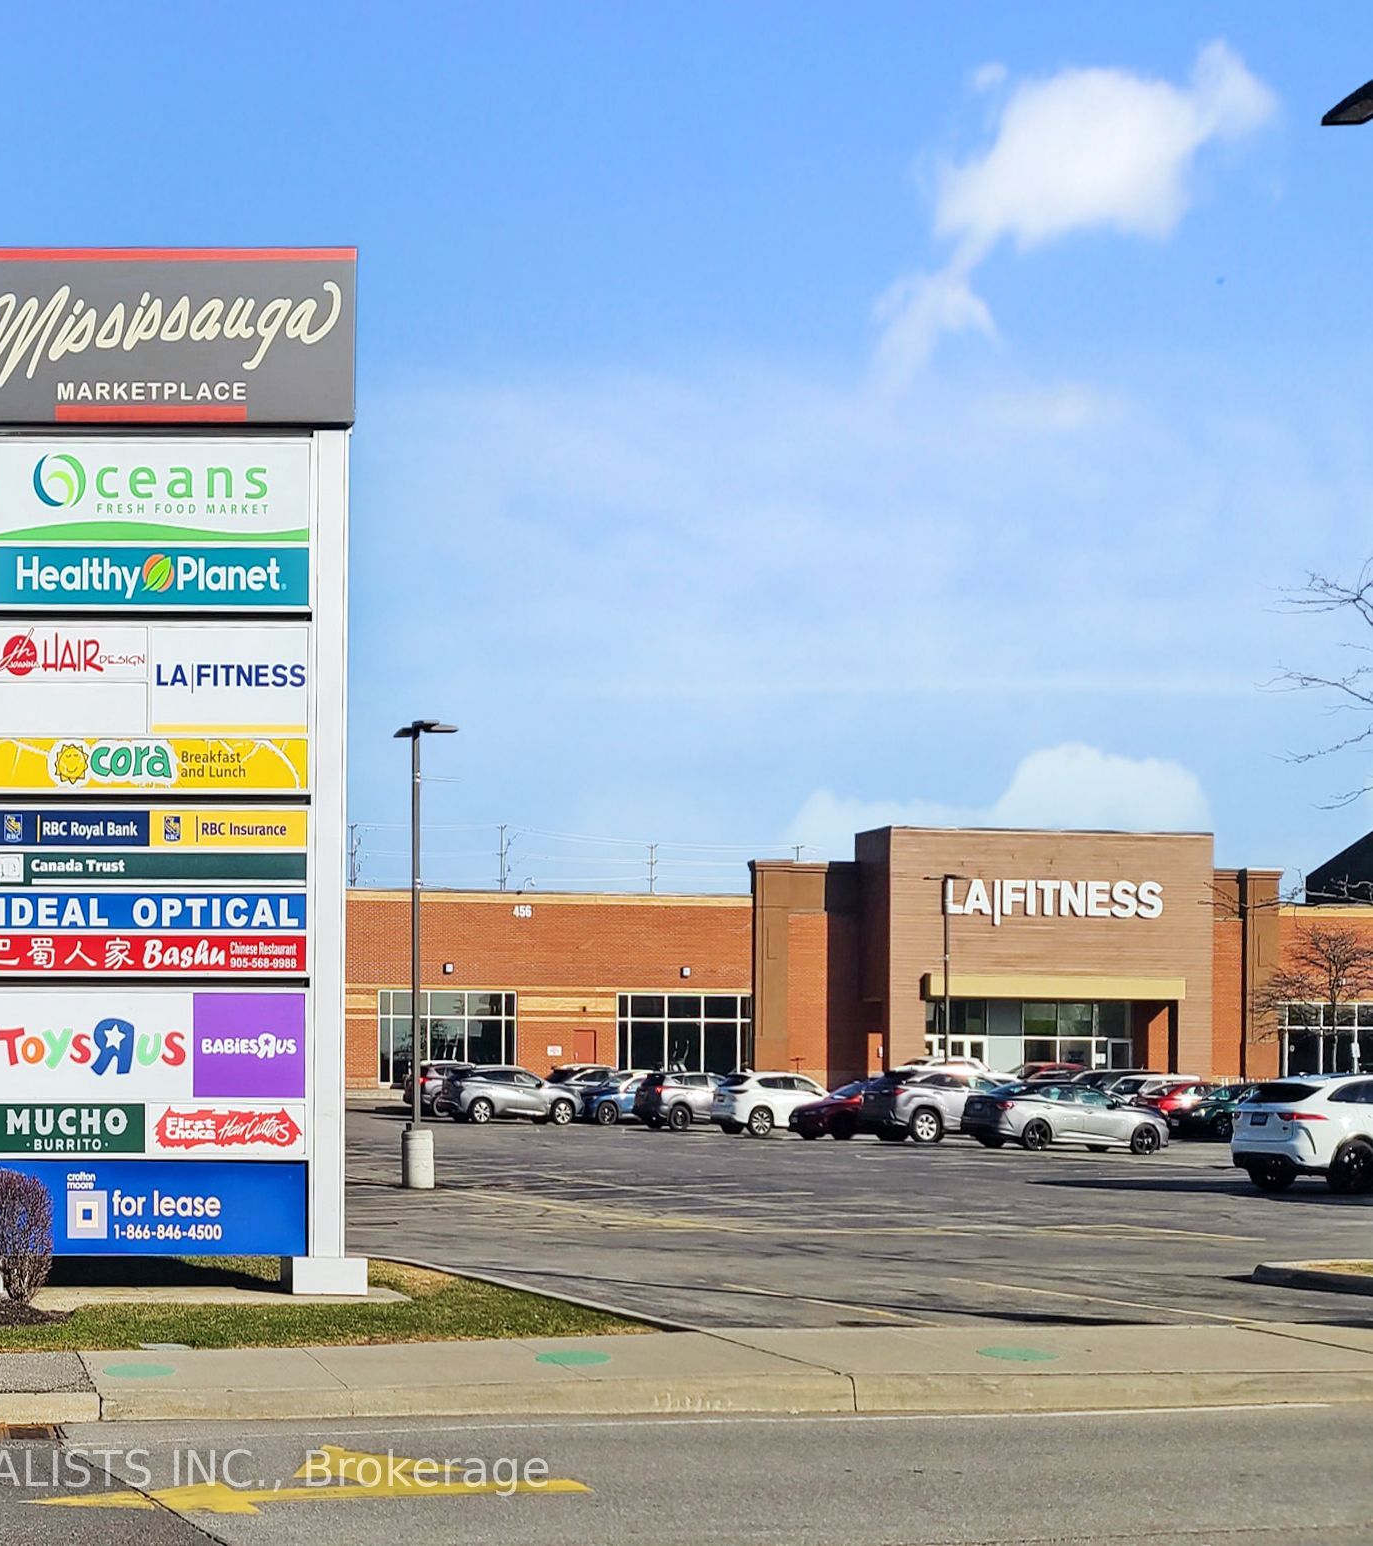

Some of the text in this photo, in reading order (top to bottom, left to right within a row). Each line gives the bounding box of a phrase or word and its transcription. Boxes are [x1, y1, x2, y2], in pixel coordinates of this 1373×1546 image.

[56, 382, 248, 400] MARKETPLACE
[96, 503, 269, 515] FRESH FOOD MARKET
[16, 556, 280, 599] Healthy Planet
[42, 632, 145, 672] HAIR DESIGN
[90, 745, 172, 778] cora
[181, 750, 241, 763] Breakfast
[181, 766, 246, 778] and Lunch
[42, 821, 138, 840] RBC Royal Bank
[201, 822, 287, 836] RBC Insurance
[31, 858, 83, 872] Canada
[86, 858, 125, 872] Trust
[132, 897, 299, 927] OPTICAL
[512, 904, 532, 918] 456
[142, 938, 226, 969] Bashu
[230, 941, 297, 956] Chinese Restaurant
[230, 957, 297, 969] 905-568-9988
[6, 1108, 128, 1136] MUCHO
[165, 1117, 216, 1129] First
[165, 1127, 217, 1140] Choice
[33, 1138, 102, 1151] BURRITO
[66, 1181, 95, 1190] moore
[112, 1189, 221, 1217] for lease
[113, 1224, 222, 1241] 1-866-846-4500
